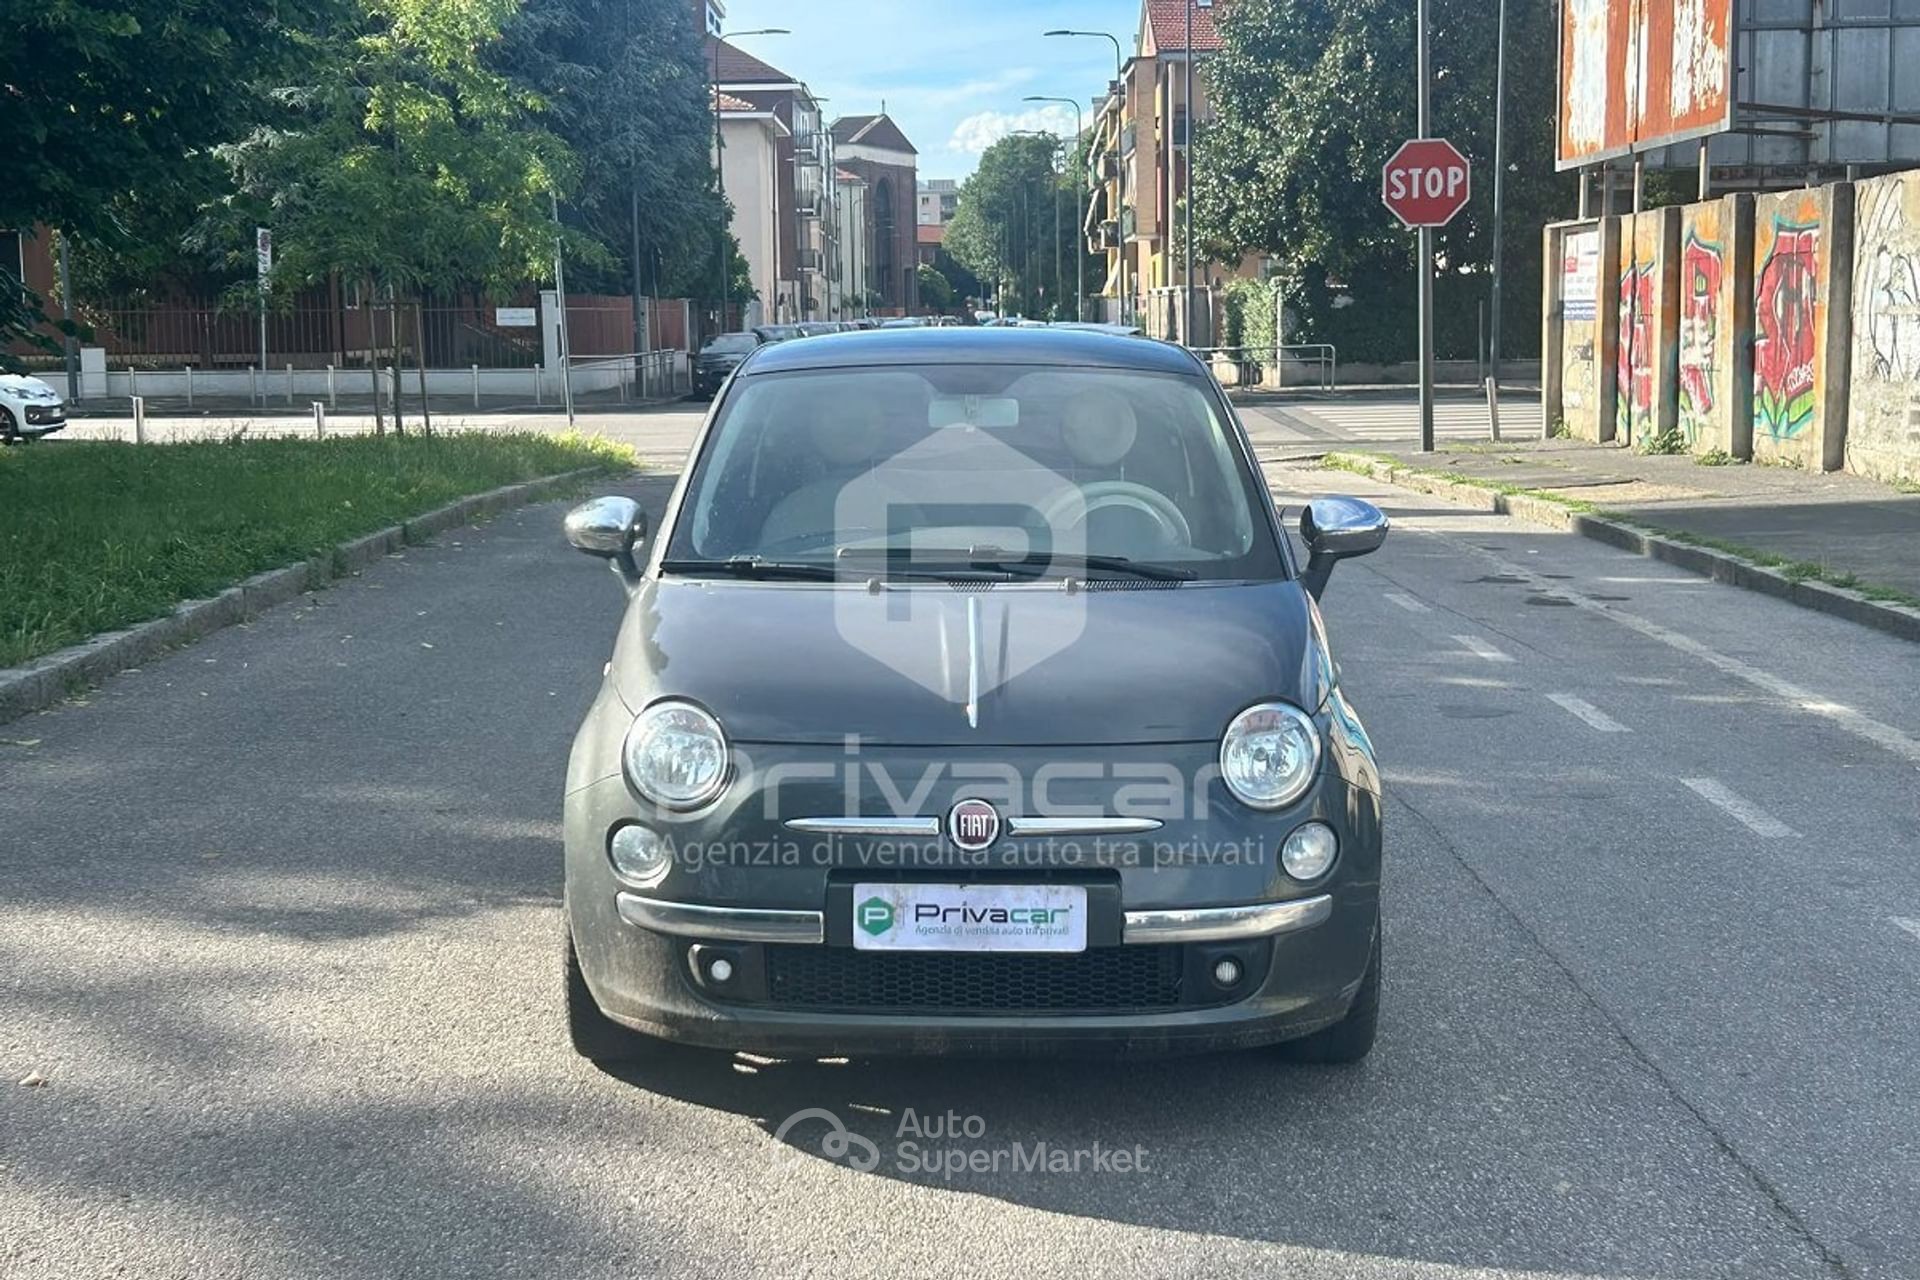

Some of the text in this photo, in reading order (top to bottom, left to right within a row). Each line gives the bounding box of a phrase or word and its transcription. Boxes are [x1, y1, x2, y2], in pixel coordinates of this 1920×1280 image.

[1390, 166, 1464, 200] STOP
[960, 814, 988, 837] FIAT
[915, 901, 1069, 923] Privacar
[915, 925, 951, 936] Agenzia
[1002, 926, 1023, 936] auto
